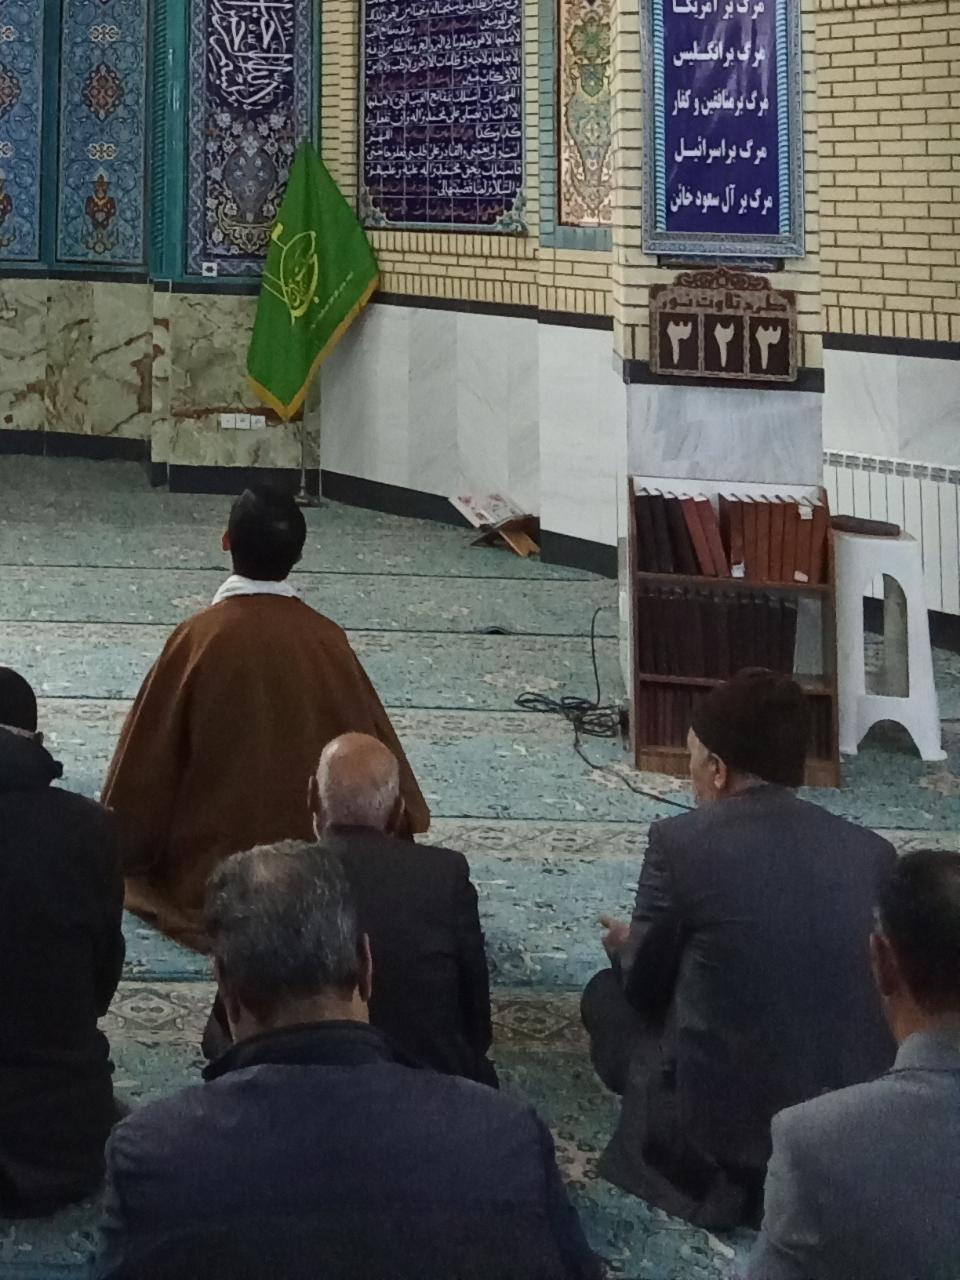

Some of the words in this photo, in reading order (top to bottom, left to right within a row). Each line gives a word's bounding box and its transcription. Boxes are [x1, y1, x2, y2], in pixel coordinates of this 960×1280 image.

[722, 0, 734, 20] بر
[673, 40, 723, 67] انگلیس
[722, 47, 734, 68] بر
[736, 40, 766, 68] مرگ
[671, 88, 692, 116] کفار
[693, 97, 699, 116] و
[700, 87, 735, 116] منافقین
[734, 95, 744, 117] بر
[745, 89, 769, 117] مرگ
[674, 135, 726, 164] اسرائیل
[725, 144, 737, 165] بر
[739, 138, 768, 165] مرگ
[670, 183, 694, 213] خائن
[695, 189, 720, 214] سعود
[721, 183, 736, 214] آل
[738, 193, 748, 215] بر
[749, 187, 773, 215] مرگ
[743, 293, 788, 314] طرح
